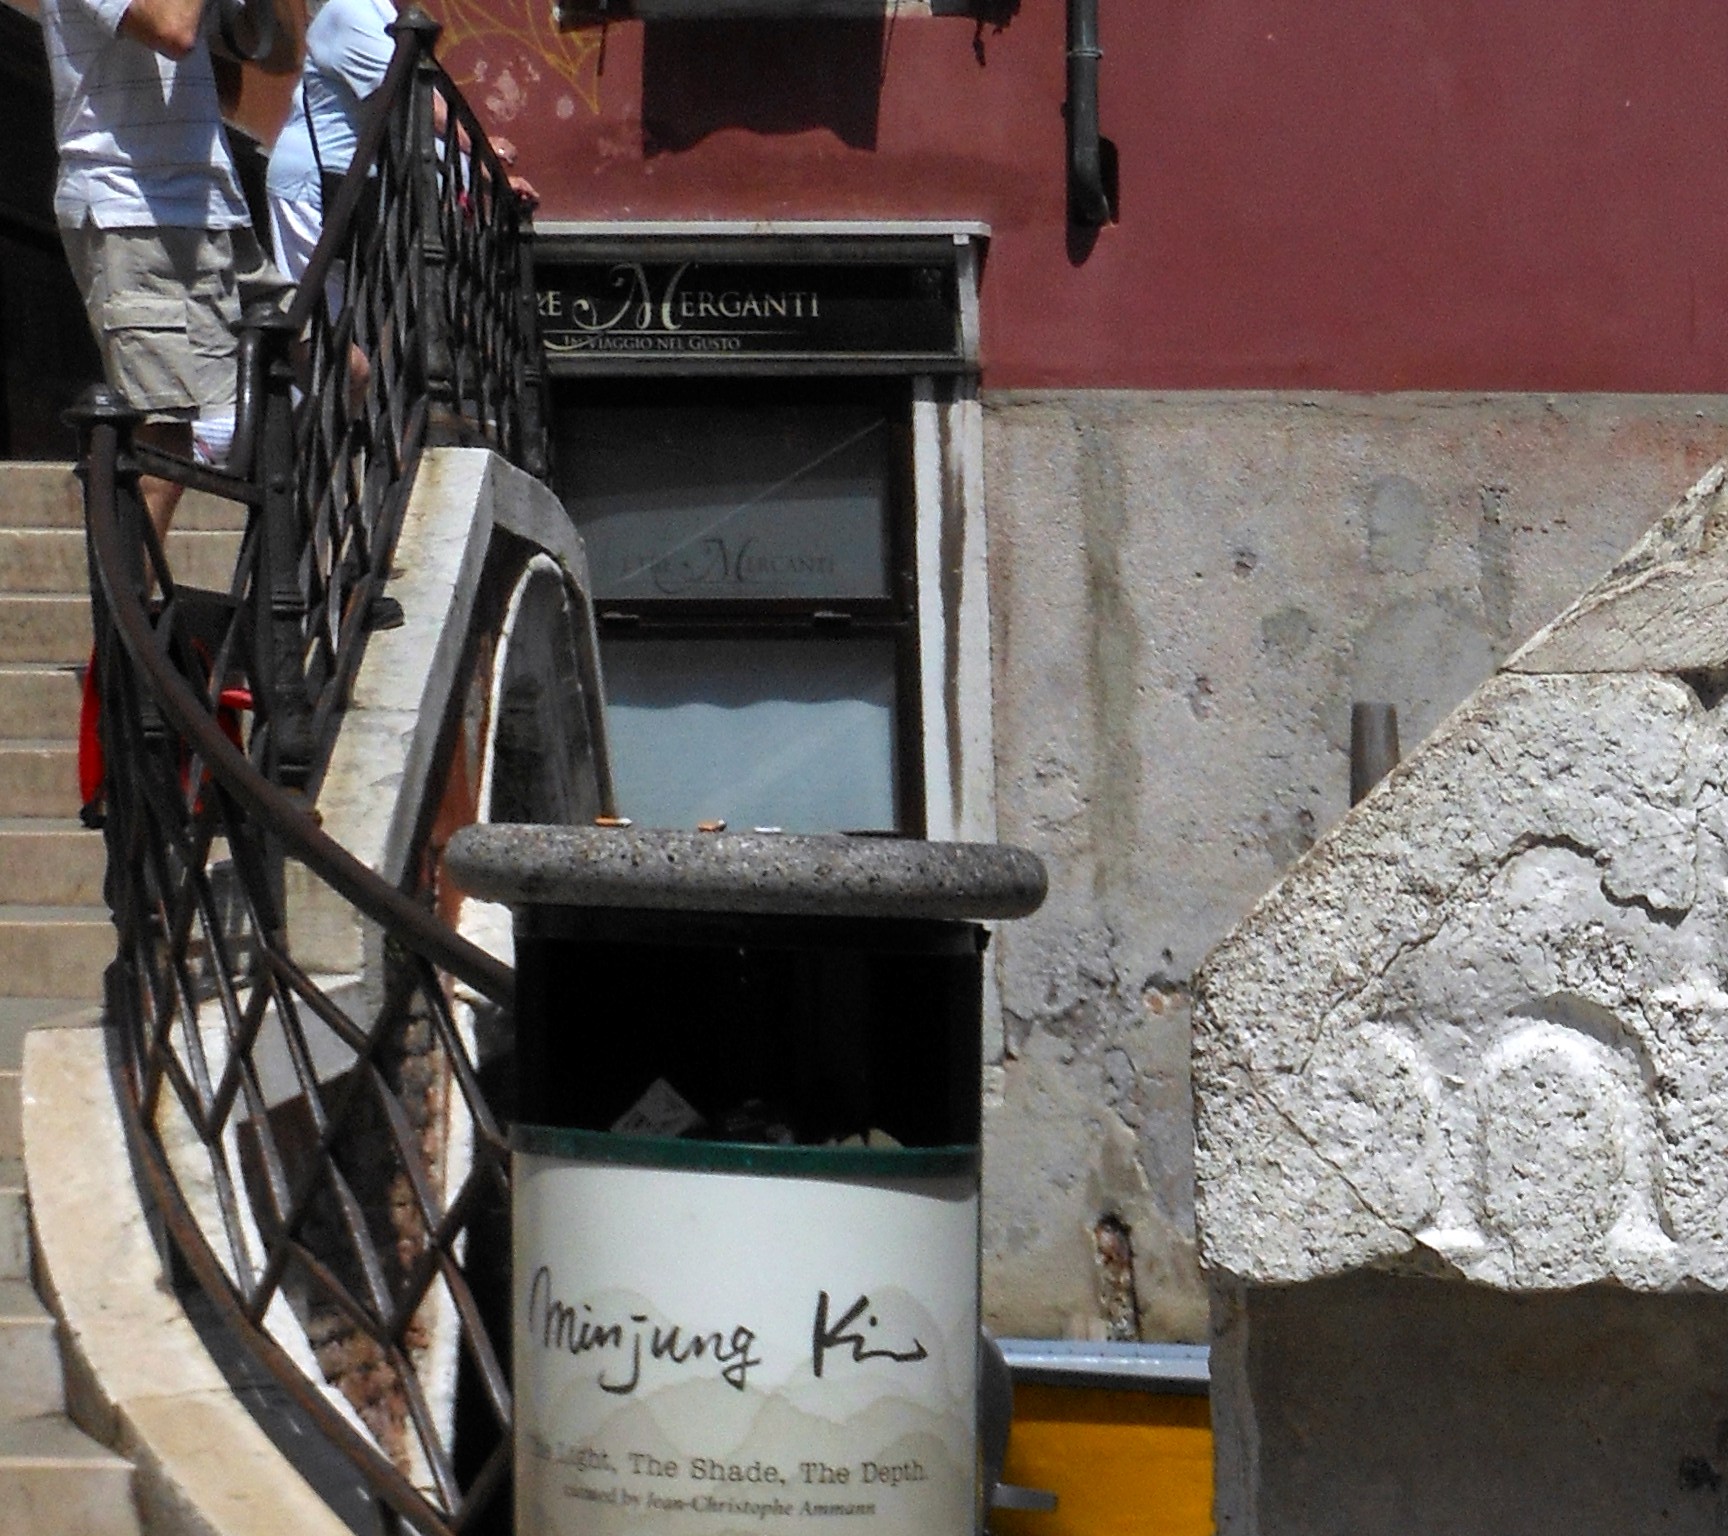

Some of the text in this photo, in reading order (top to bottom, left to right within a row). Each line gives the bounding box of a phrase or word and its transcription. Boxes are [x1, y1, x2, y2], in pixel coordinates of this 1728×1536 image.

[688, 335, 741, 351] GUSTO
[528, 1265, 762, 1395] Minjung
[627, 1449, 680, 1479] The
[690, 1456, 786, 1487] Shade,
[800, 1460, 851, 1486] The
[800, 1498, 876, 1518] Ammann
